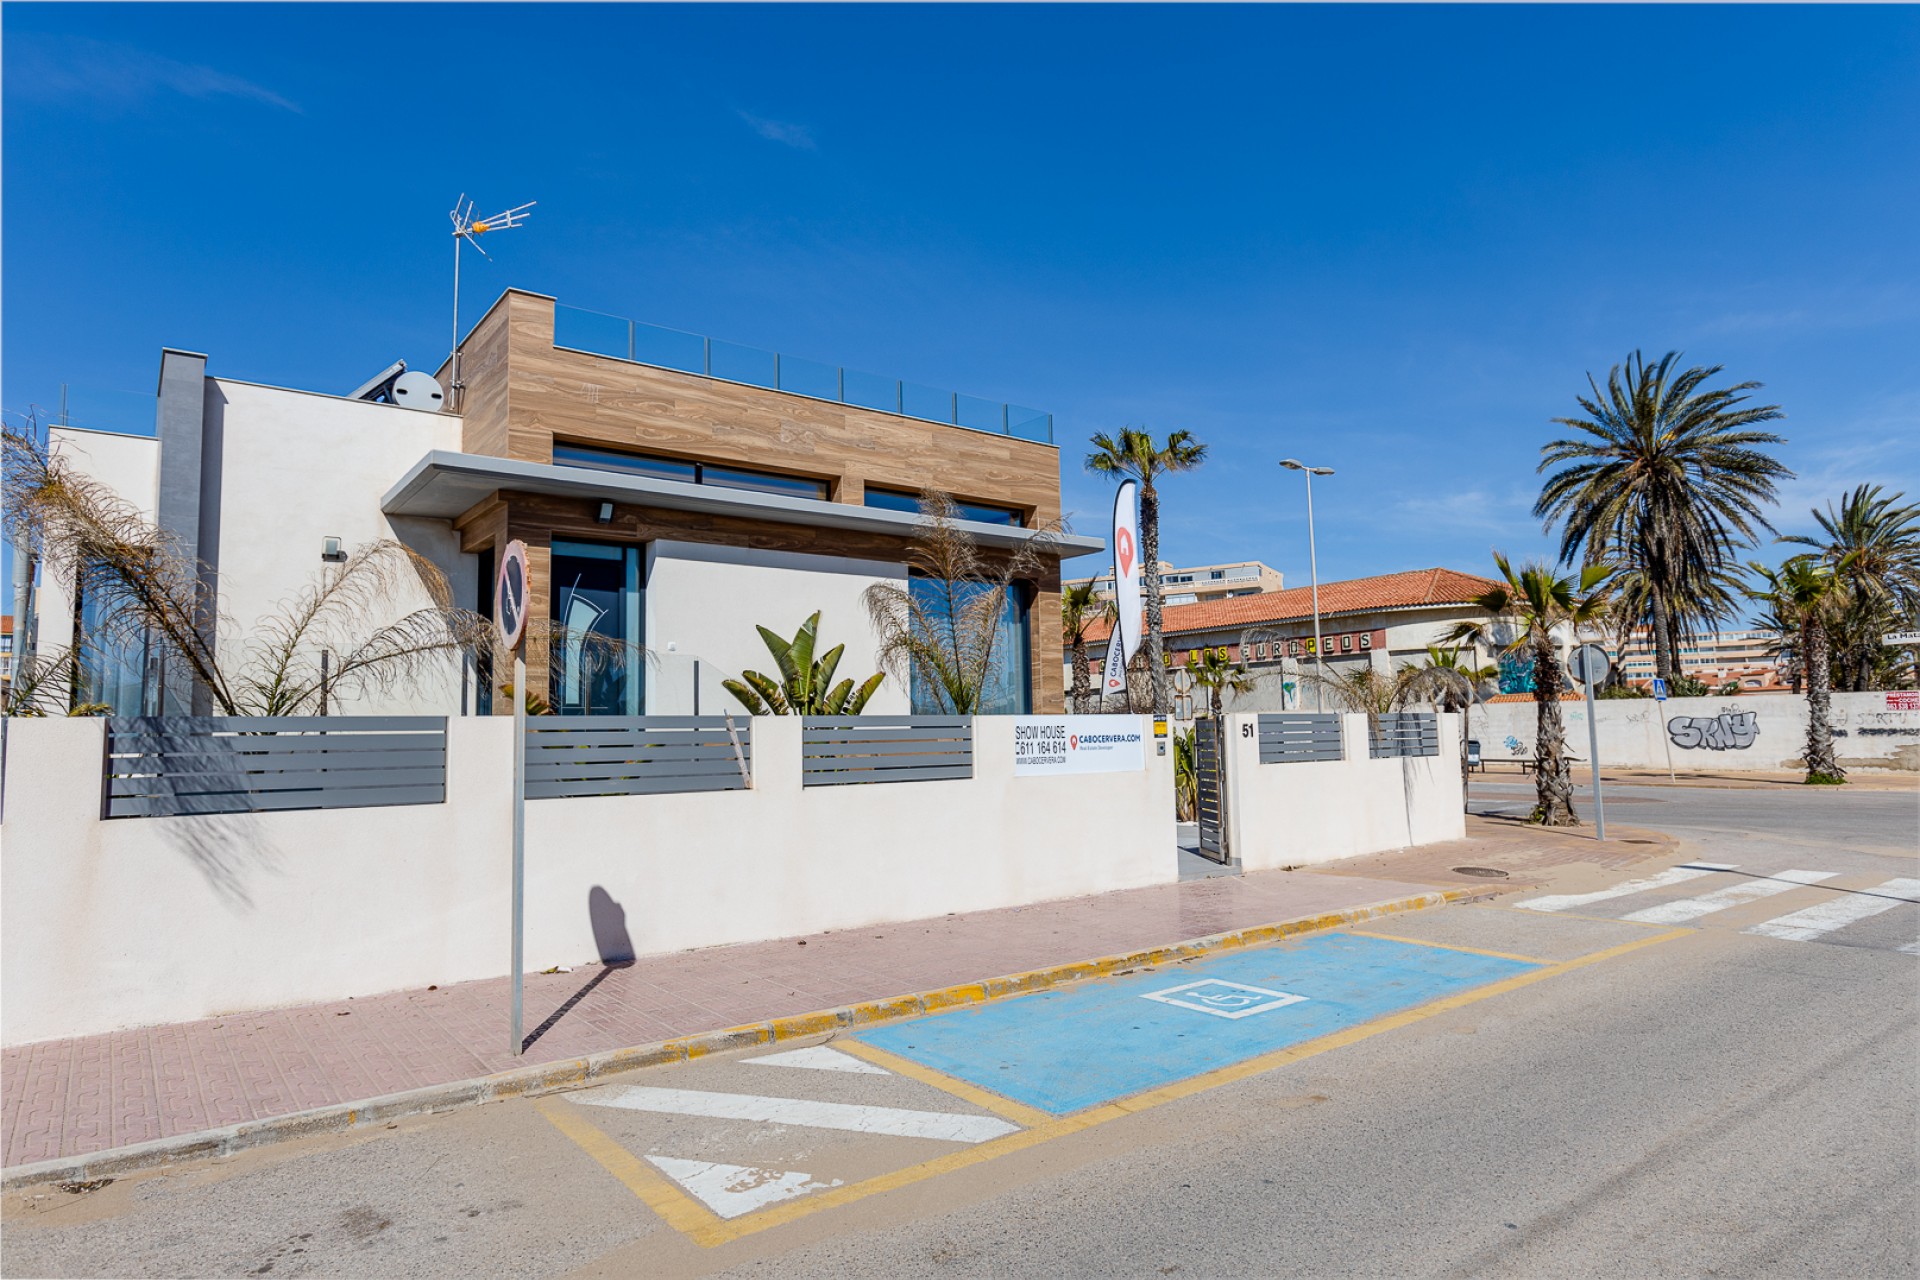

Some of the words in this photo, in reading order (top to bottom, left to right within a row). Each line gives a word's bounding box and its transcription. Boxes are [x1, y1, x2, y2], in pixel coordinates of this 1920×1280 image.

[1243, 633, 1370, 657] EUROPEOS
[1015, 725, 1039, 740] SHOW
[1040, 725, 1066, 739] HOUSE
[1242, 723, 1254, 738] 51
[1078, 734, 1141, 744] CABOCERVERA.COM
[1020, 741, 1034, 755] 611
[1037, 741, 1051, 754] 164
[1052, 740, 1067, 754] 614
